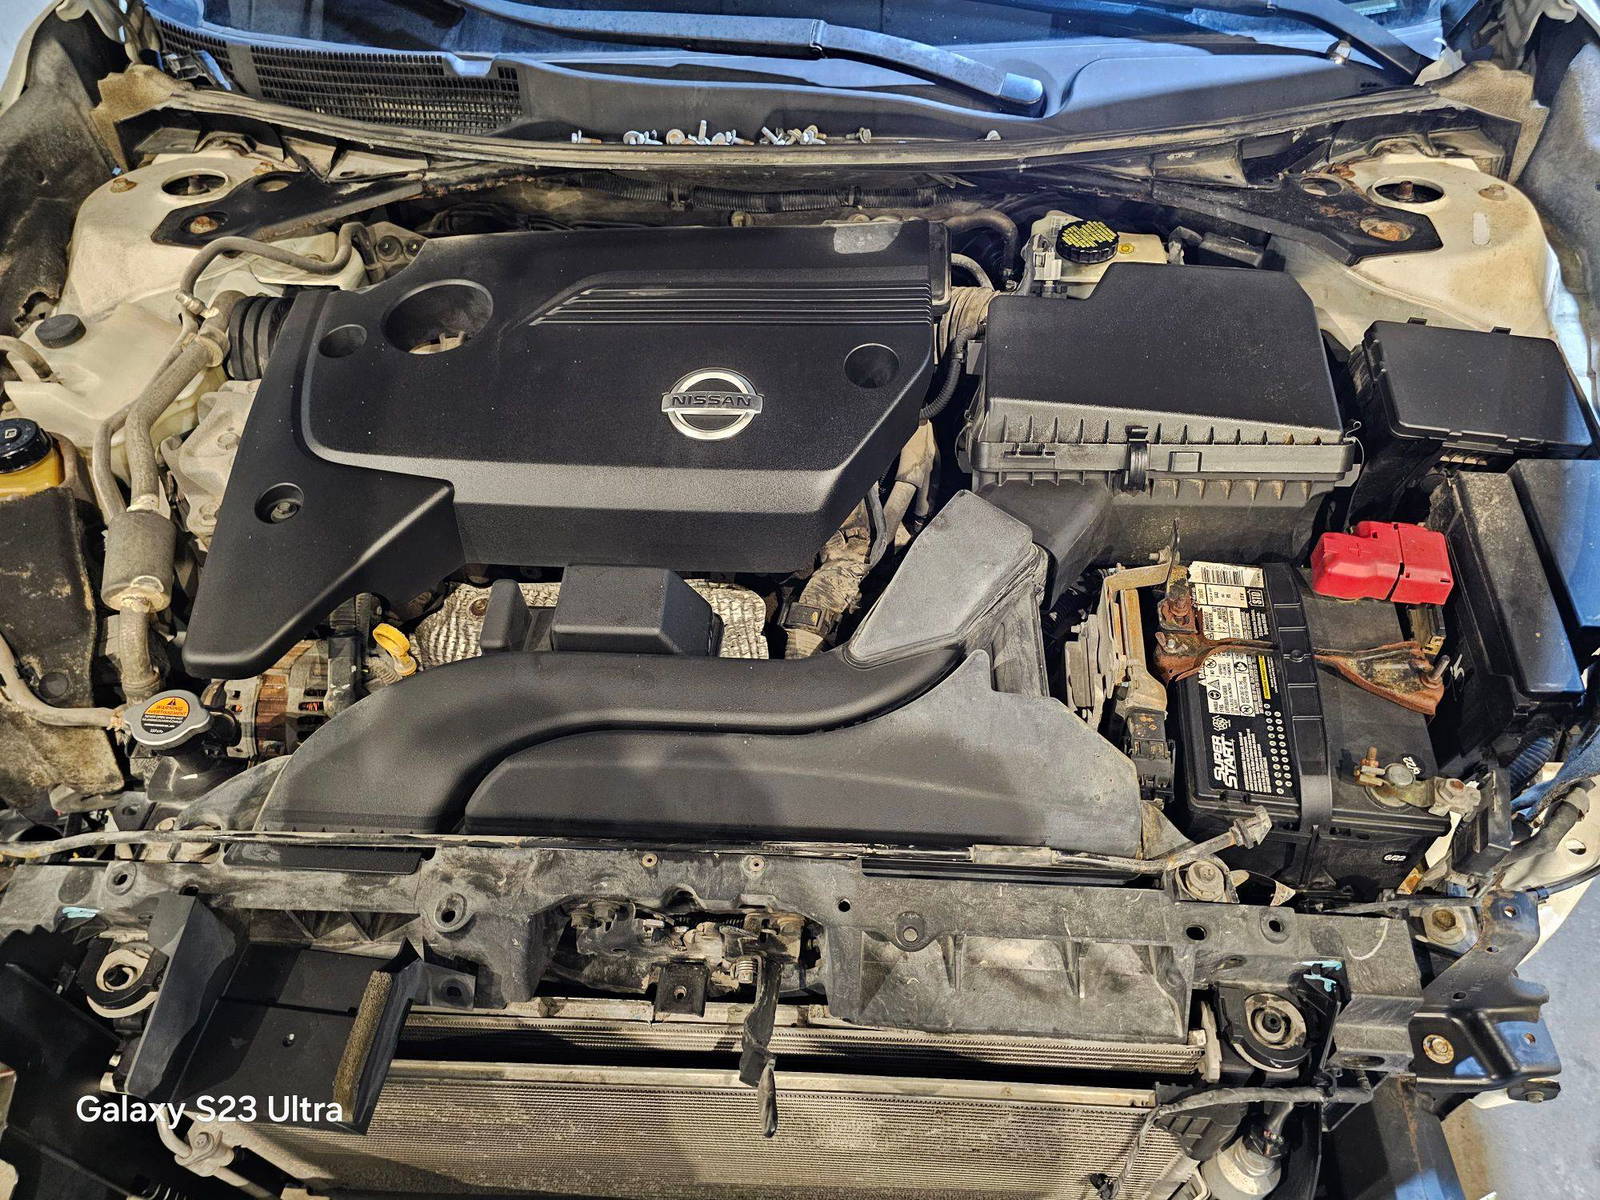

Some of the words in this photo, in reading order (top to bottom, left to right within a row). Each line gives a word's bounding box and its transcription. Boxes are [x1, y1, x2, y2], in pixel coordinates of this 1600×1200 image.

[672, 395, 752, 407] NISSAN
[1212, 735, 1226, 781] SUPER
[1221, 735, 1239, 790] START
